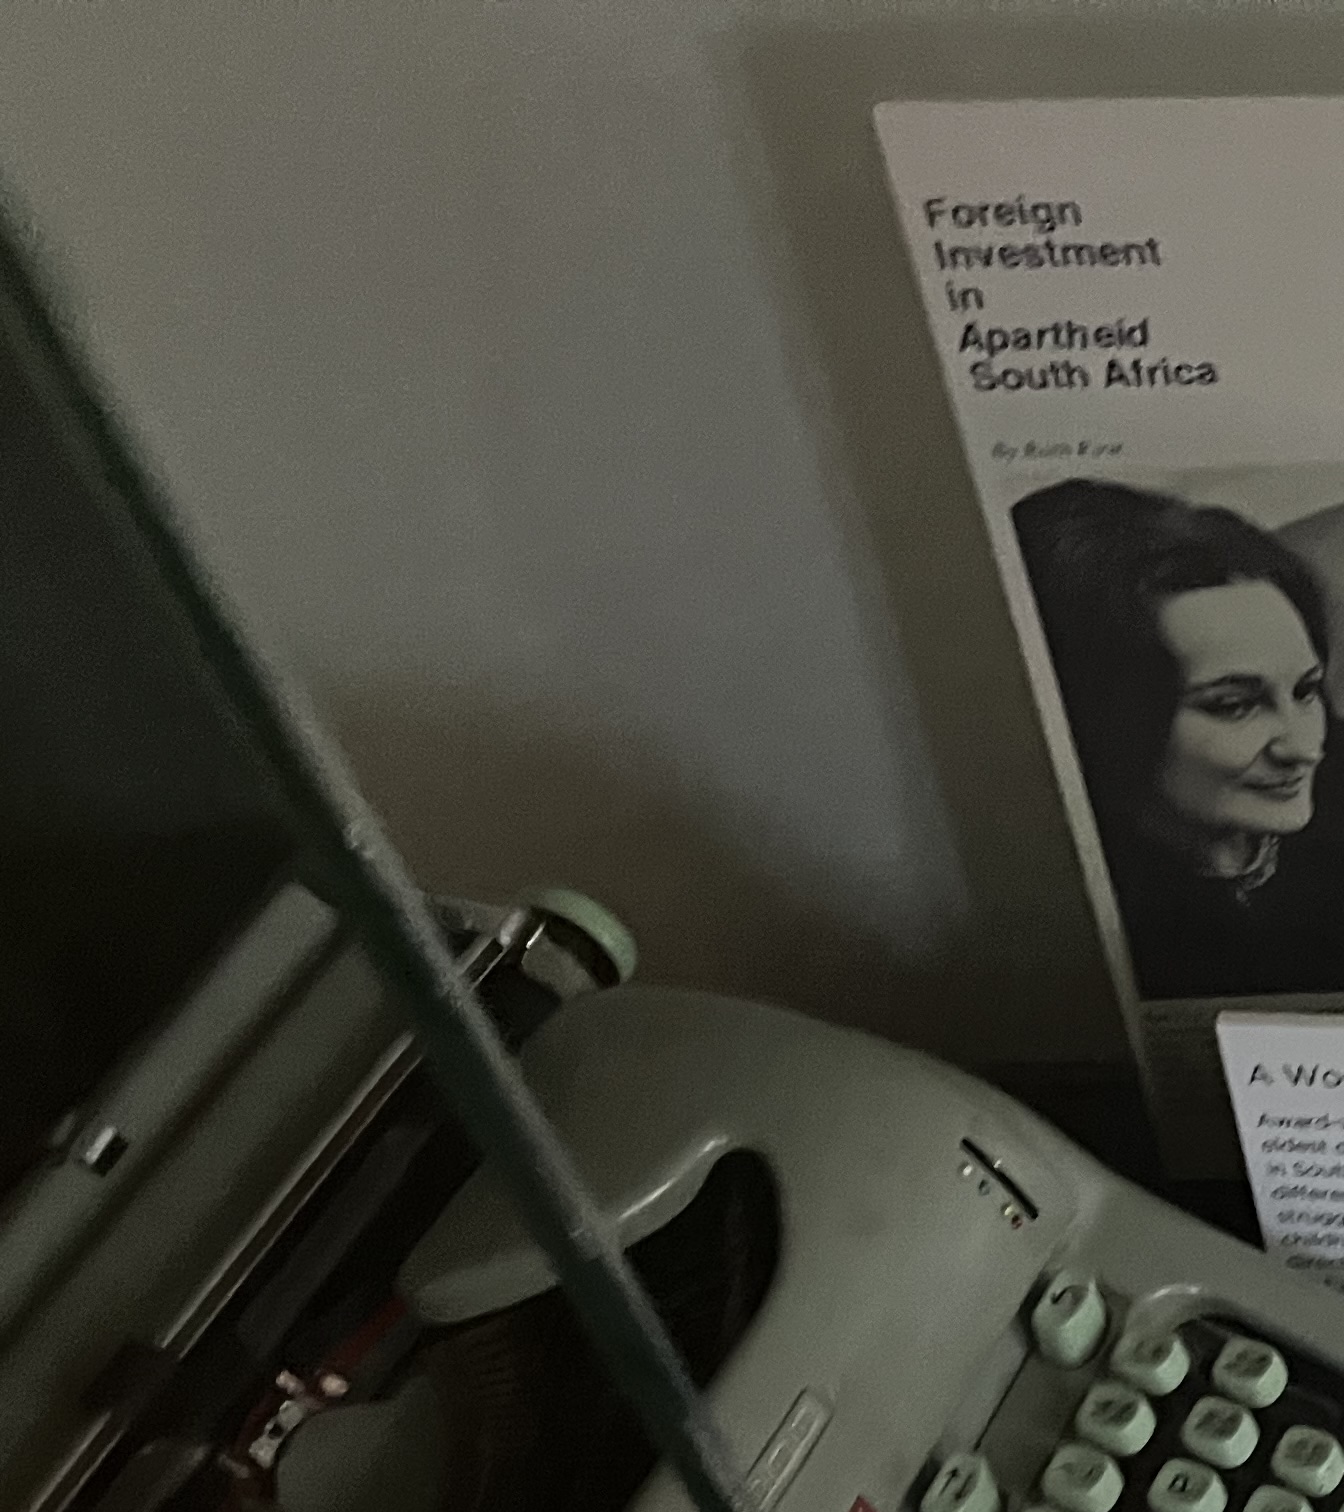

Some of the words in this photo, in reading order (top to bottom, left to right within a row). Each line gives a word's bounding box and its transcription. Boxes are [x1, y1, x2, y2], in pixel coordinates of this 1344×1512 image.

[922, 194, 1082, 234] Foreign
[934, 237, 1161, 270] Investment
[959, 317, 1148, 358] Apartheid
[969, 358, 1089, 391] South
[1104, 357, 1219, 388] Africa
[1249, 1064, 1274, 1086] A
